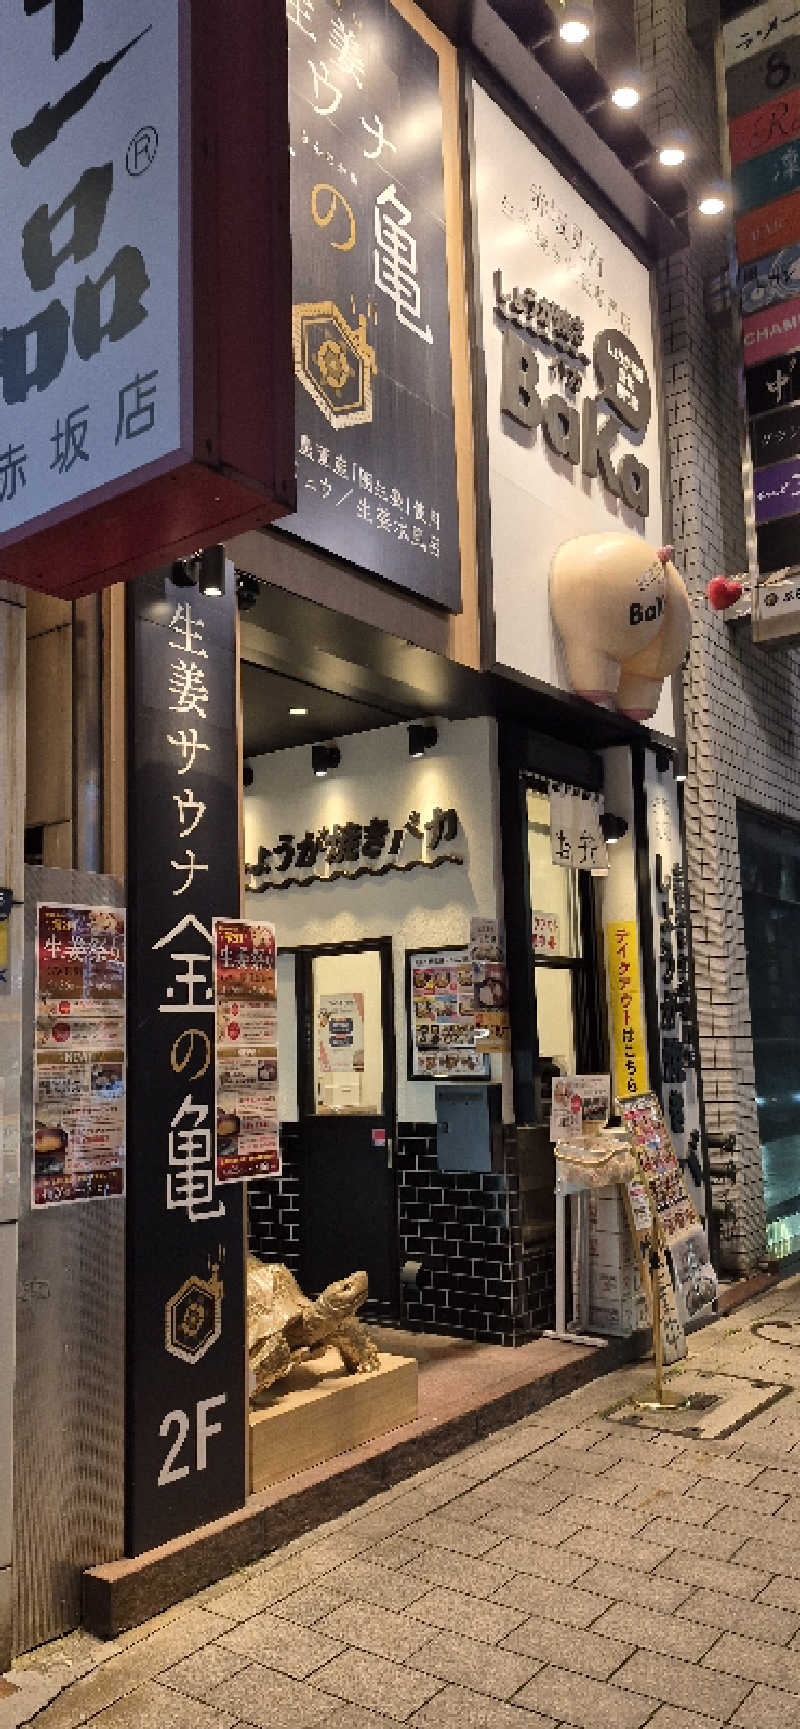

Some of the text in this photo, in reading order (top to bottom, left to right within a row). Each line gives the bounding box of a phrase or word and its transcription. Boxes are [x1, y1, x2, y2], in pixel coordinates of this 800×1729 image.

[0, 369, 158, 501] 赤坂店
[168, 602, 211, 896] 生姜サウナ
[151, 914, 226, 1223] 金の亀
[615, 929, 638, 1093] テイクアウトはこちら
[158, 1392, 226, 1487] 2F
